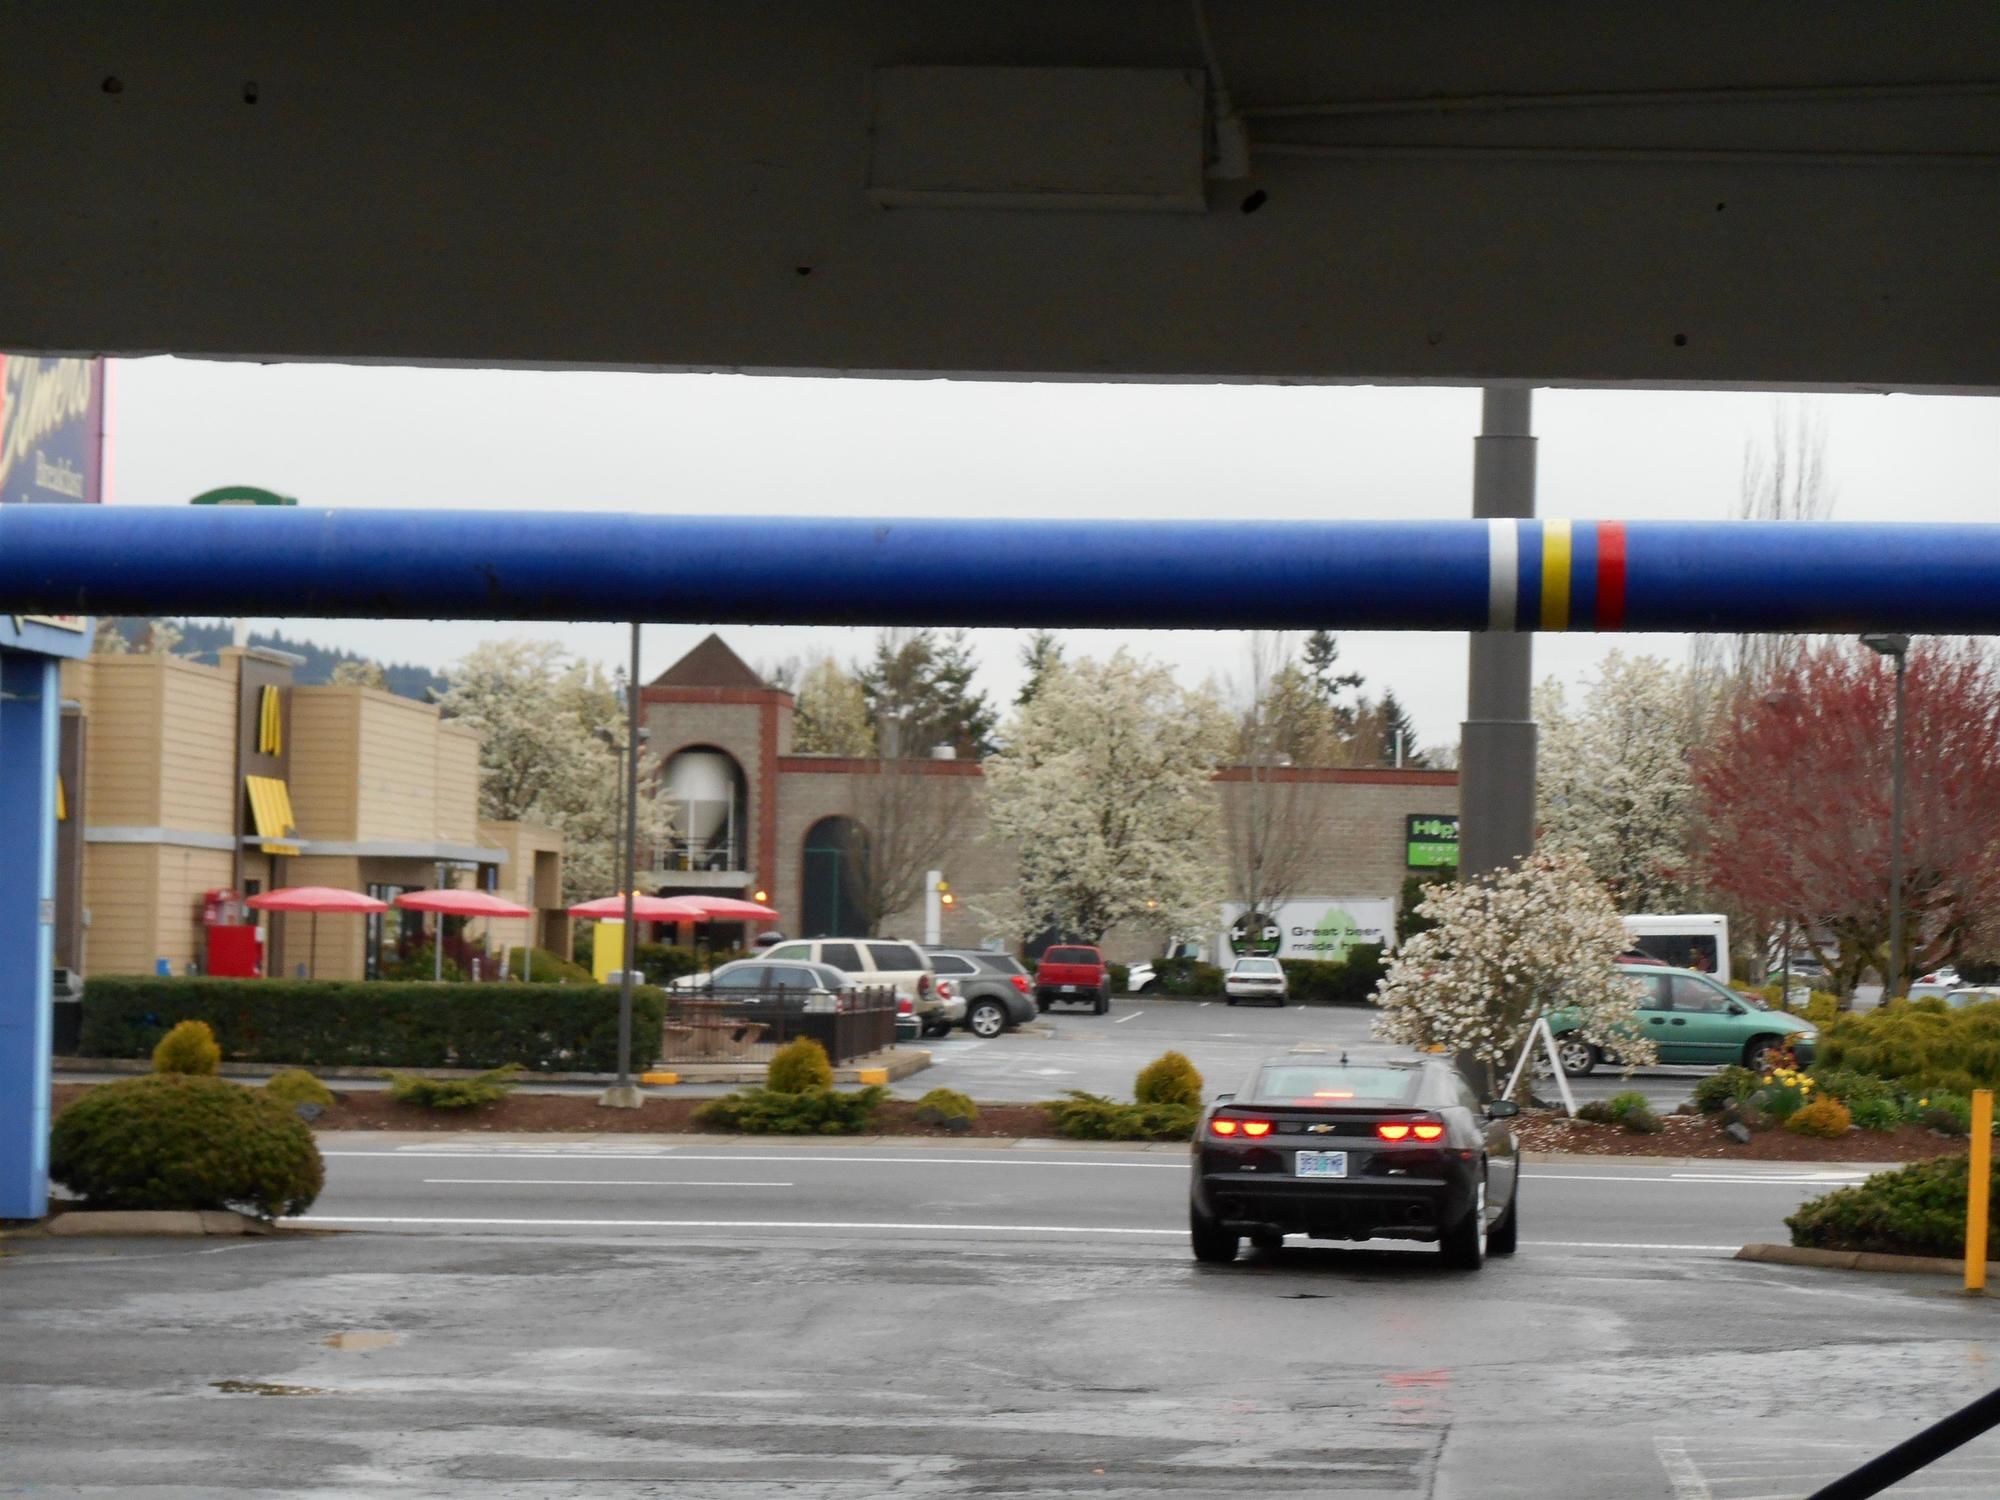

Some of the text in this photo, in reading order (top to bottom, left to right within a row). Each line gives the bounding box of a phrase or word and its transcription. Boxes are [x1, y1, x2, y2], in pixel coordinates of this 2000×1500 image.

[1231, 926, 1280, 941] HP
[1291, 926, 1338, 936] Great
[1291, 941, 1335, 951] made
